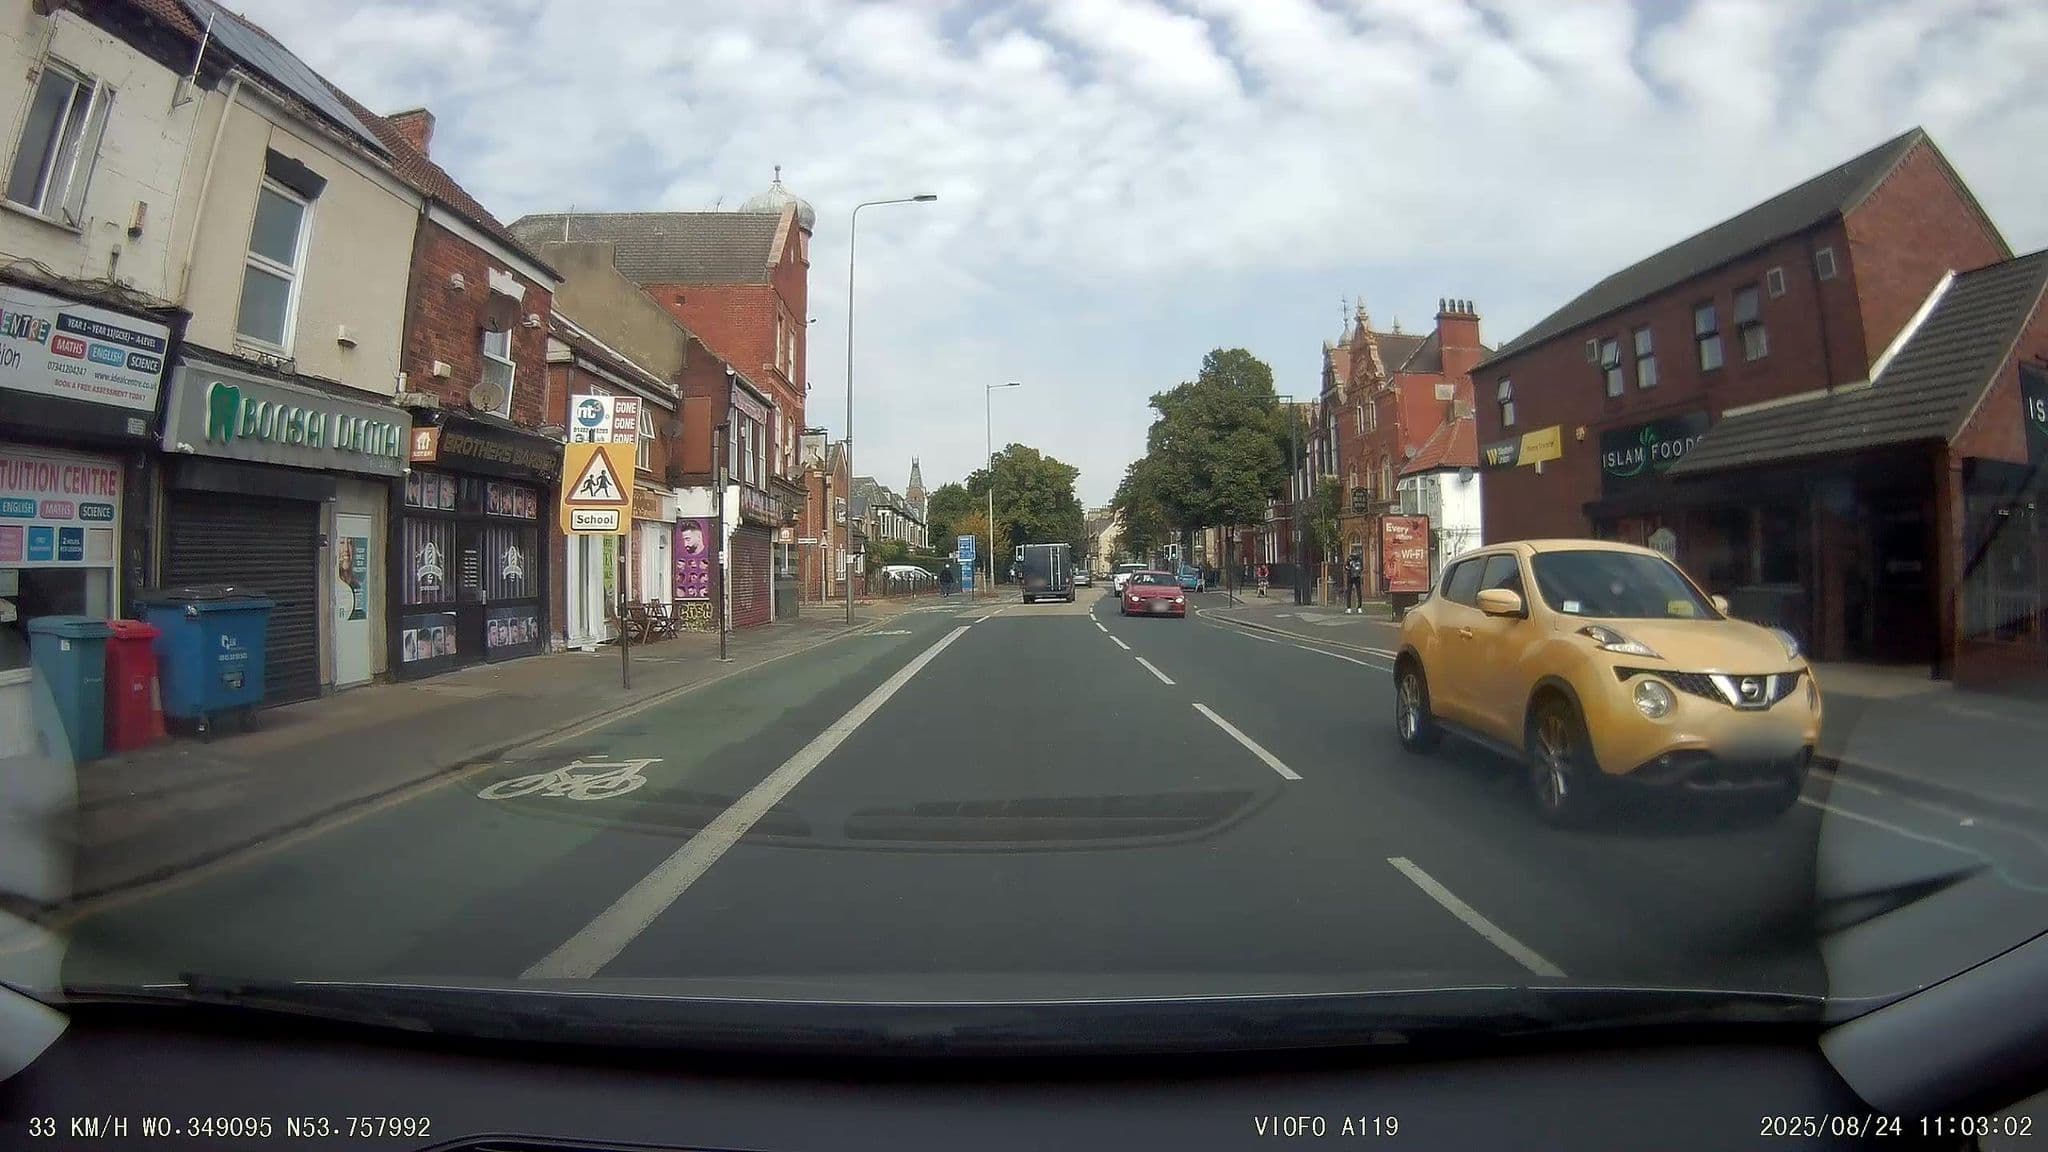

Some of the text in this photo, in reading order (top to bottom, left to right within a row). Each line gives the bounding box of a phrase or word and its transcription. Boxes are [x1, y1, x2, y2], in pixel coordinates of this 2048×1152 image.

[0, 312, 49, 341] ENTRE
[67, 318, 83, 330] YEAR
[92, 324, 106, 336] YEAR
[0, 343, 21, 370] ion
[56, 338, 159, 372] MATHS ENGLISH SCIENCE
[616, 402, 637, 414] GONE
[615, 417, 636, 430] GONE
[443, 432, 511, 463] BROTHERS
[613, 433, 634, 444] GONE
[1602, 447, 1643, 468] ISLAM
[0, 460, 118, 497] TUITION CENTRE
[2, 501, 111, 518] ENGLISH MATHS SCIENCE
[576, 514, 614, 525] School
[1386, 522, 1409, 535] Every
